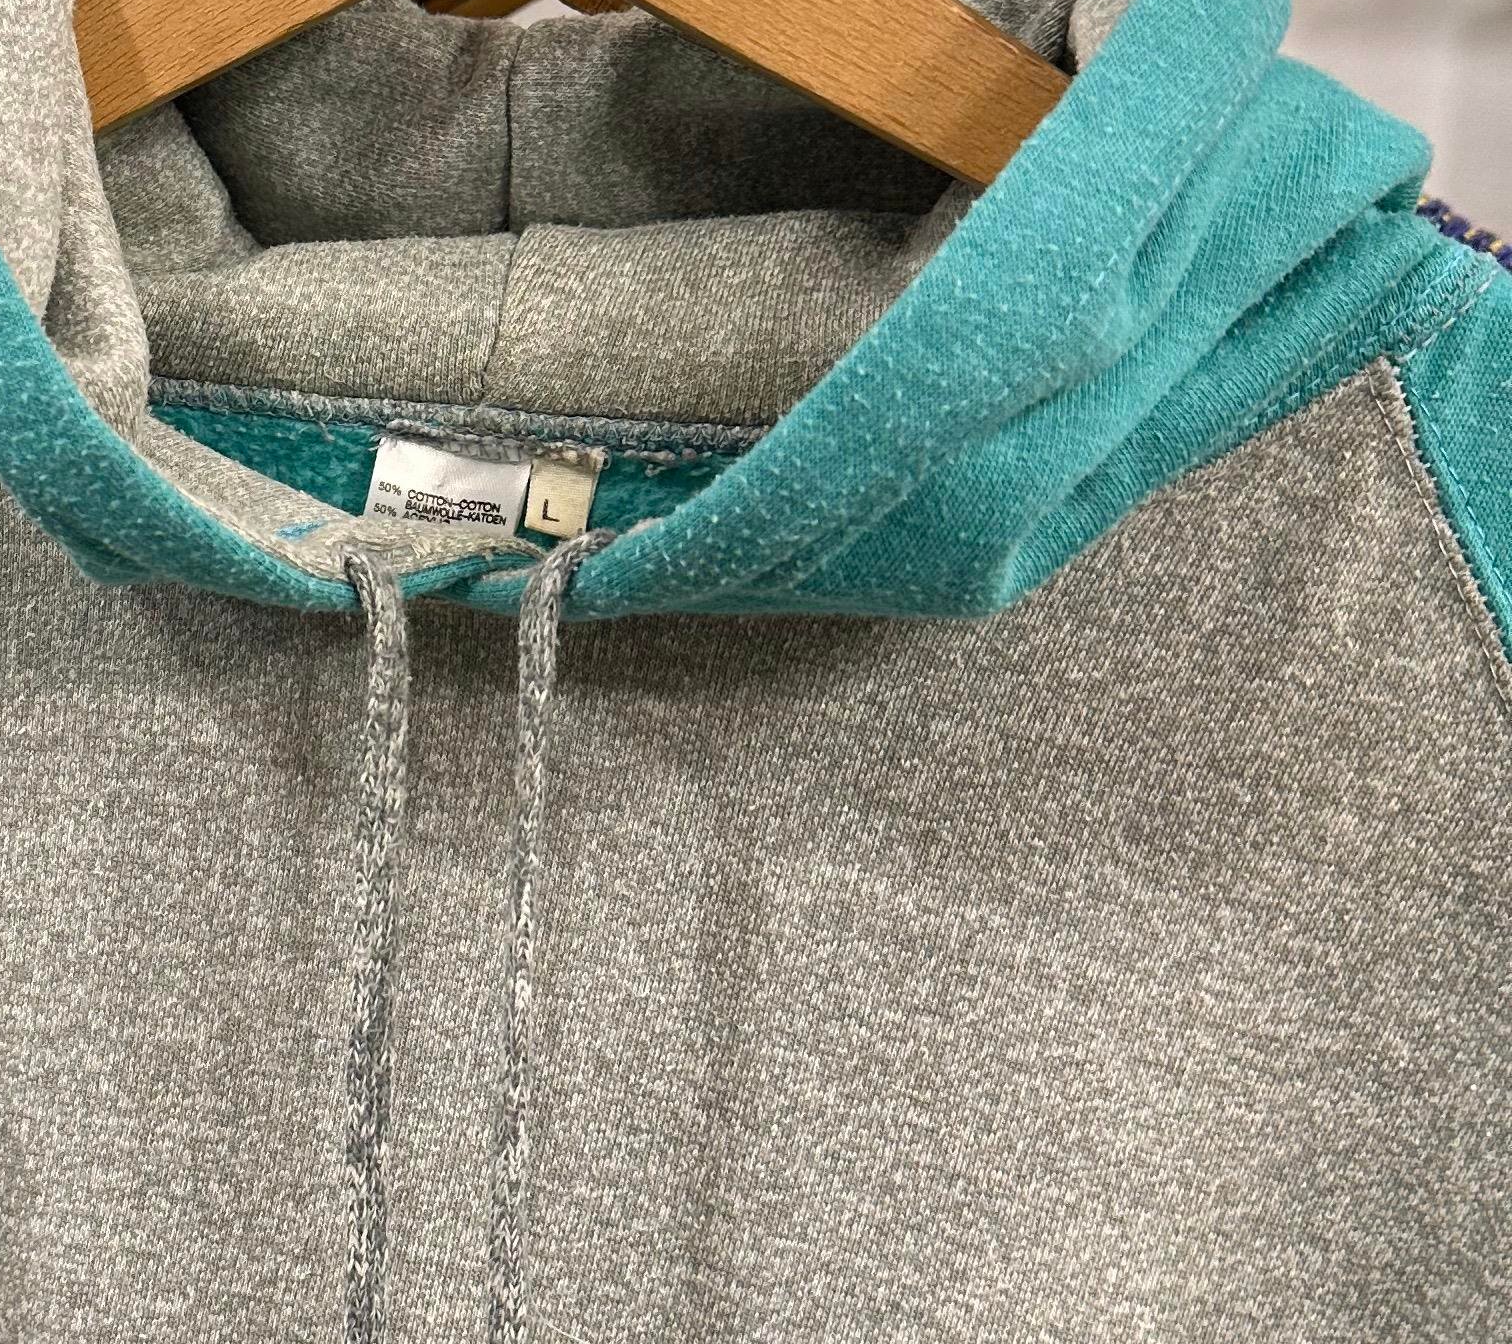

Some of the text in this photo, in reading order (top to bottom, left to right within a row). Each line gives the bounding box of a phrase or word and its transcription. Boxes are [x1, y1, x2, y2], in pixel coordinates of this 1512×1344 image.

[373, 502, 398, 517] 50%
[377, 480, 502, 514] 50% COTTON-COTON
[541, 497, 561, 524] L
